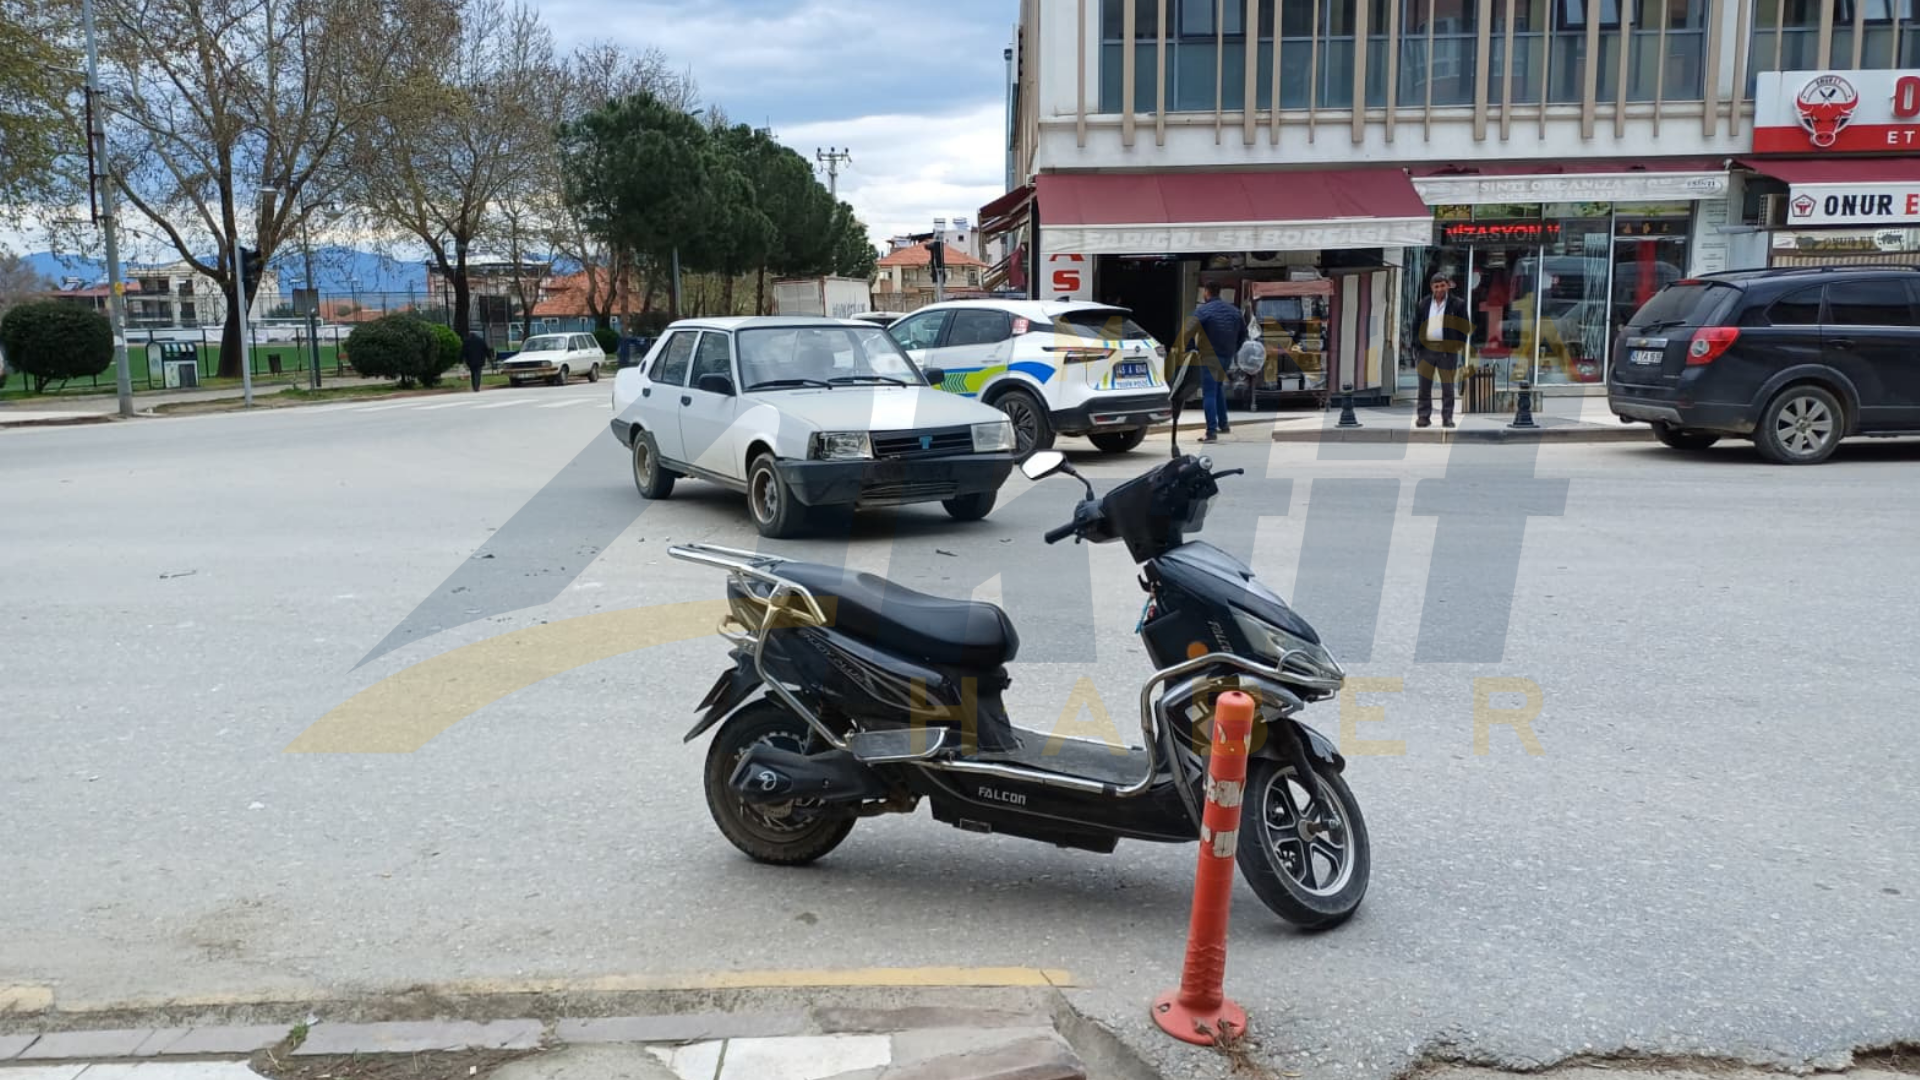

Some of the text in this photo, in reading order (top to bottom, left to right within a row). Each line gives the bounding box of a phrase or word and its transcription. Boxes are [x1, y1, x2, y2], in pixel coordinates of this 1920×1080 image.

[1887, 131, 1916, 144] ET
[1824, 193, 1919, 216] ONUR E
[978, 786, 1027, 806] FALCON
